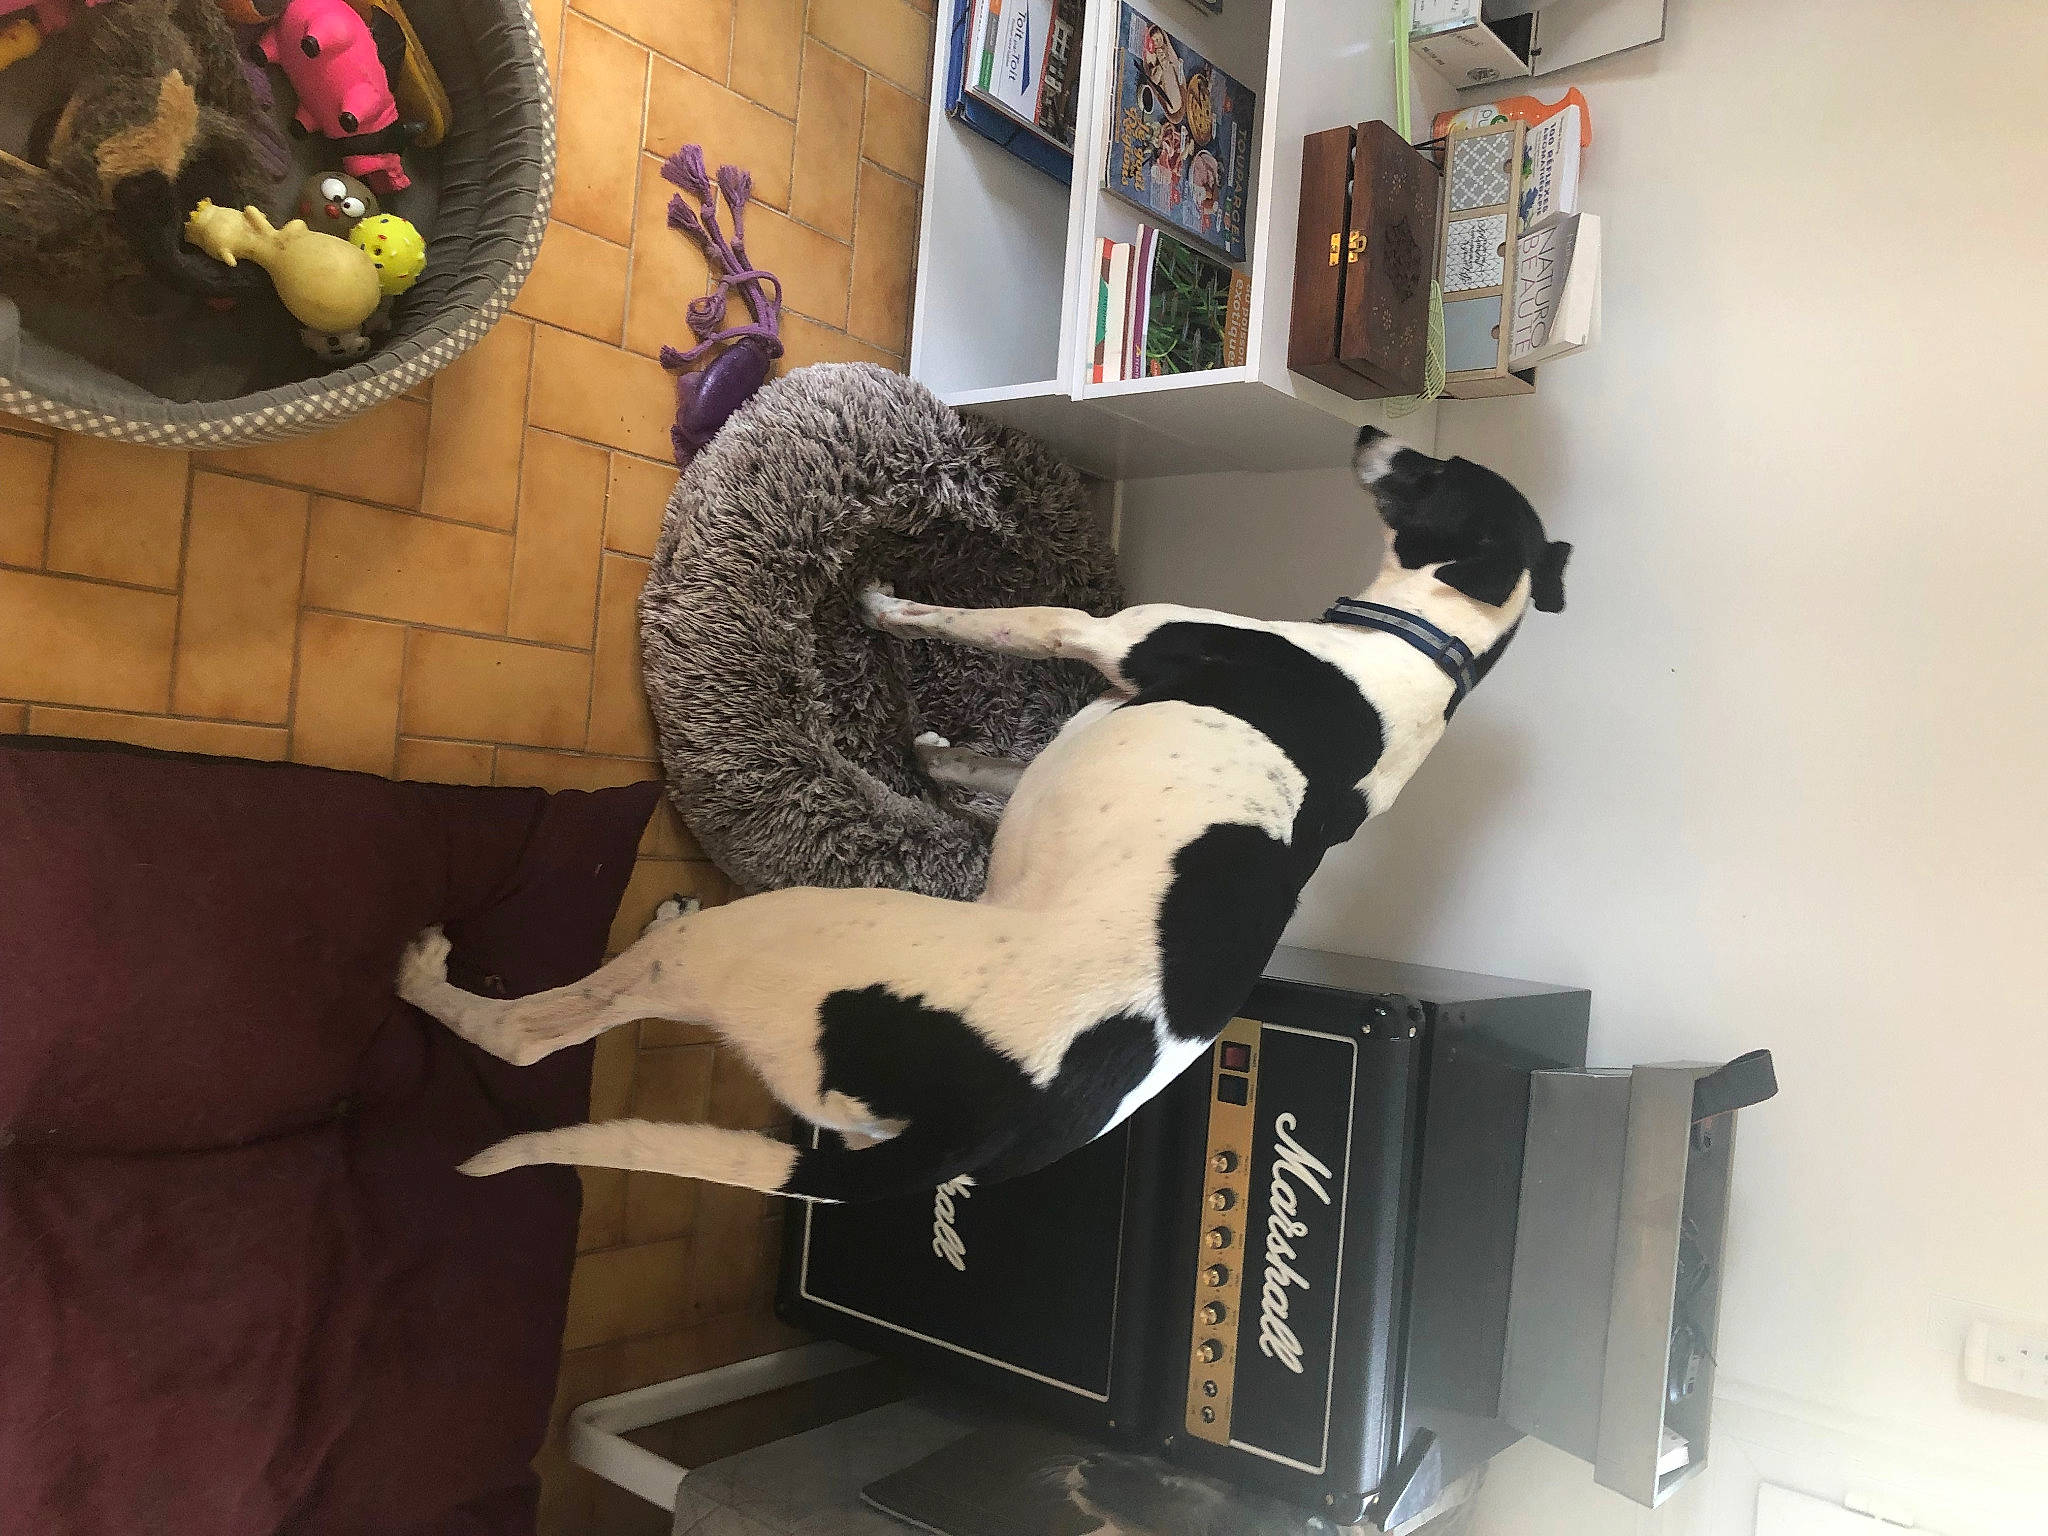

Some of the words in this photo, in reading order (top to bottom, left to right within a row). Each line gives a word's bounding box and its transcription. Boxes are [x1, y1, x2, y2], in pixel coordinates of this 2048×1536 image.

[1015, 11, 1027, 40] Toit
[1008, 54, 1020, 81] Toit
[1547, 122, 1557, 146] 100
[1531, 226, 1558, 349] NATURO
[931, 1178, 975, 1271] hall
[1257, 1112, 1334, 1375] Marshall
